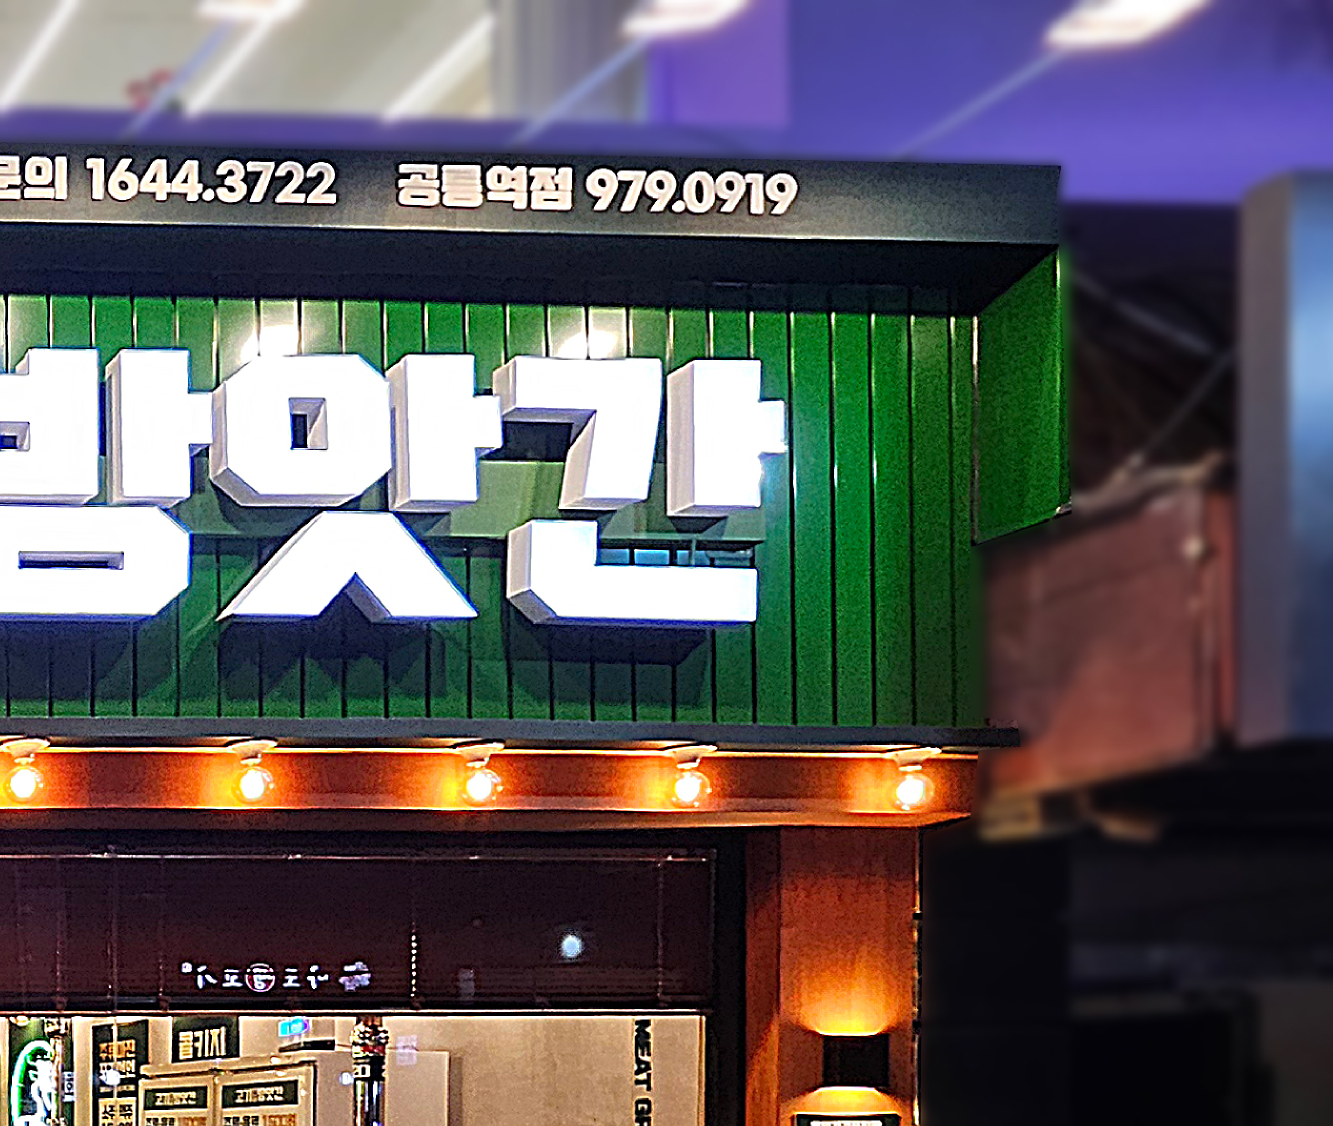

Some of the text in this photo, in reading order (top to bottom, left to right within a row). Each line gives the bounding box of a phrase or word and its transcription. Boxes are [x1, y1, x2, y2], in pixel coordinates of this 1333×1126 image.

[85, 157, 337, 206] 1644.3722
[396, 164, 799, 217] 공릉역점 979.0919
[634, 1019, 652, 1091] MEAT
